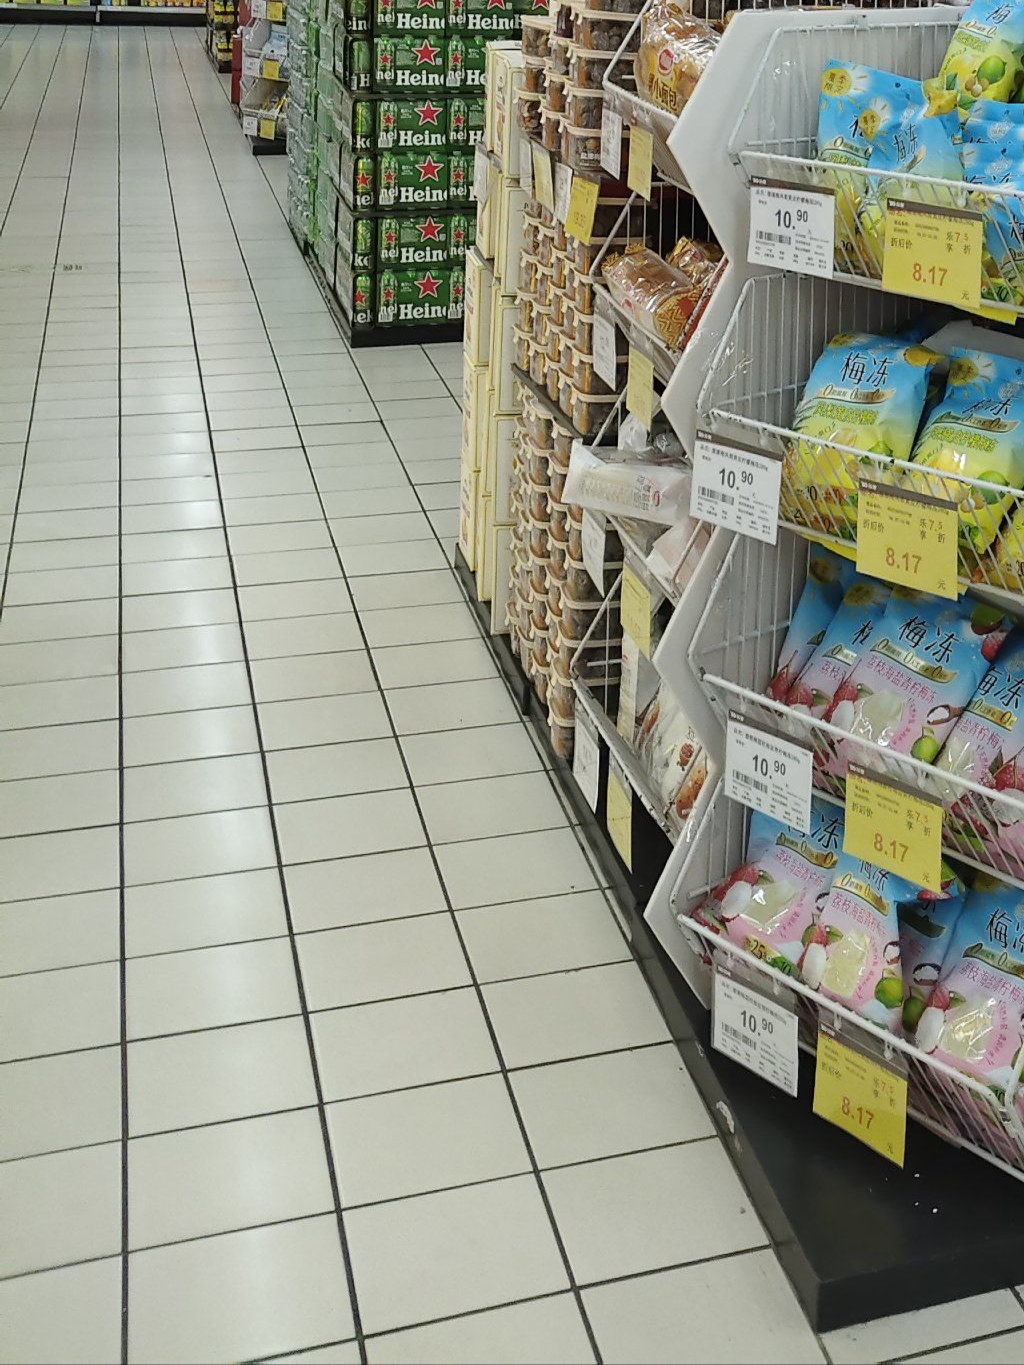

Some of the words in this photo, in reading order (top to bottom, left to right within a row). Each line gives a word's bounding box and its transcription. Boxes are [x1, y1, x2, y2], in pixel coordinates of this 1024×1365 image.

[912, 262, 948, 286] 8.17
[841, 352, 893, 387] 梅冻
[886, 547, 922, 574] 8.17
[899, 616, 960, 663] 梅冻
[873, 832, 909, 862] 8.17
[840, 1096, 875, 1131] 8.17
